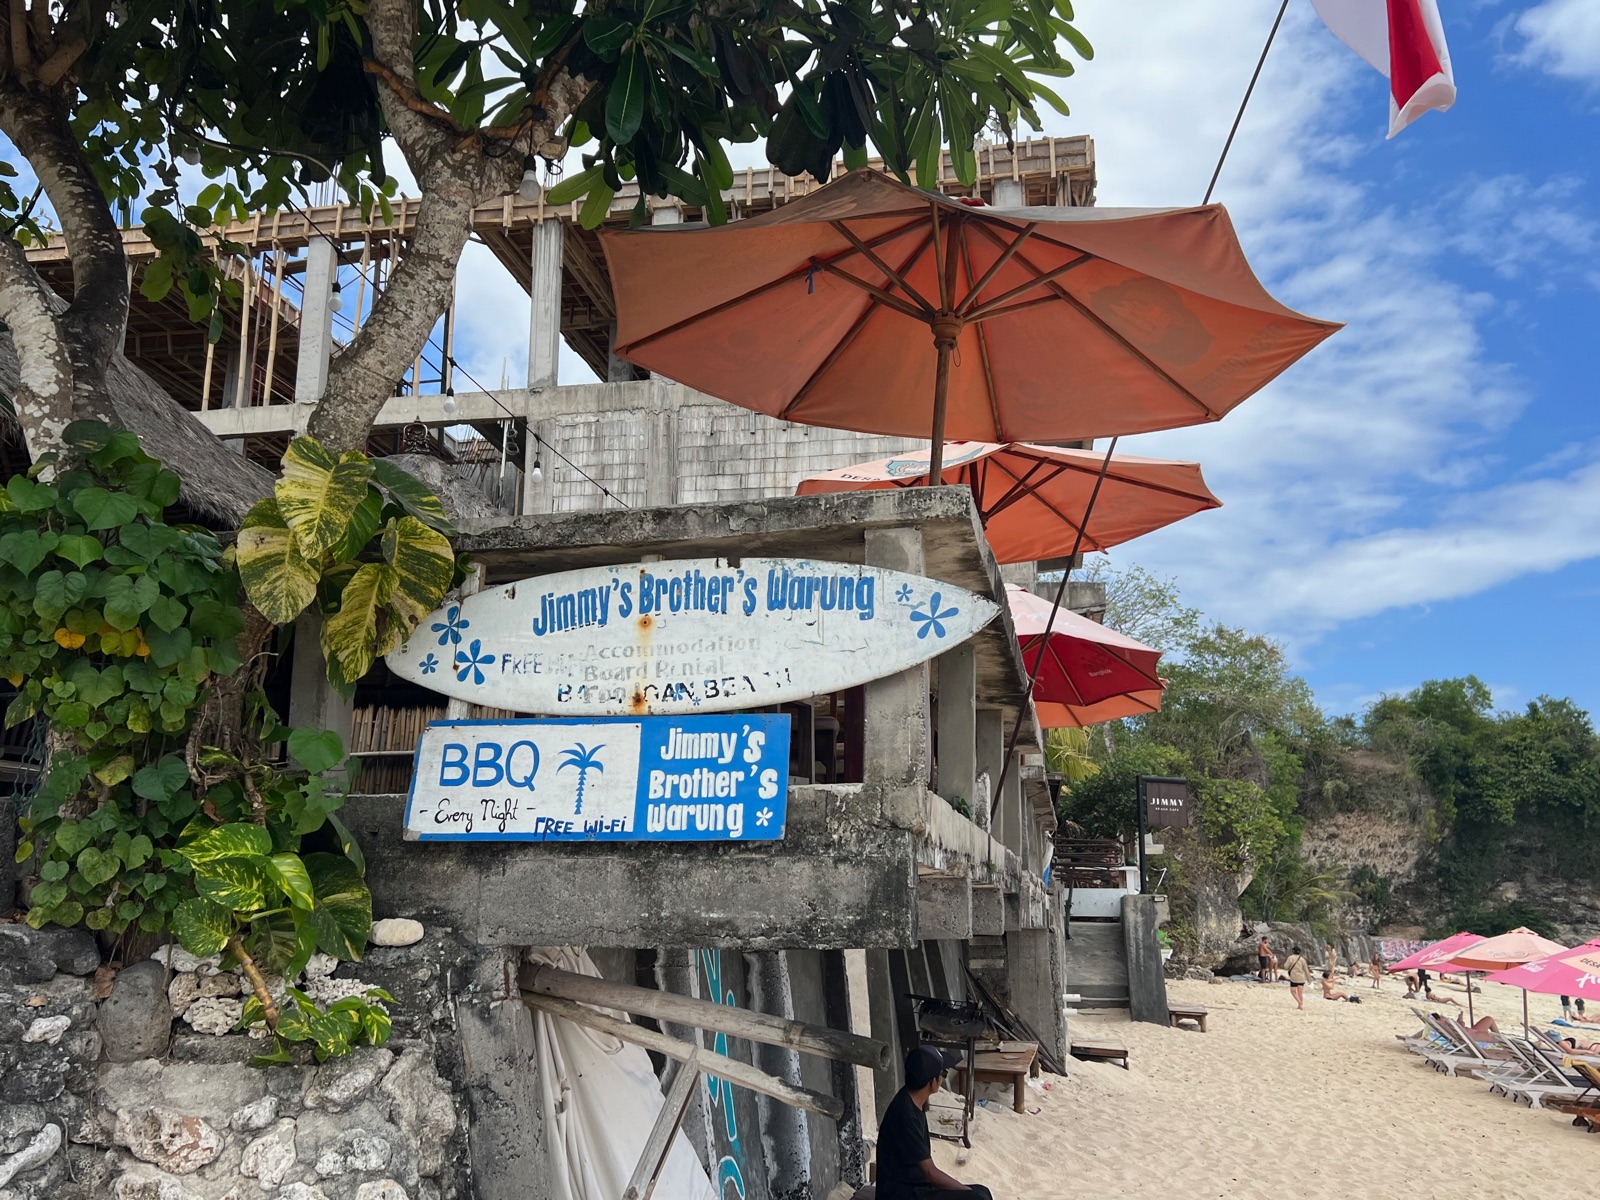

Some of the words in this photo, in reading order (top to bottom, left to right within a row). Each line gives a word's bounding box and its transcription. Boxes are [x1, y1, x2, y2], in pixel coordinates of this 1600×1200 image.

[532, 578, 633, 637] Jimmy's
[639, 569, 757, 618] Brother's
[767, 569, 875, 620] Warung
[583, 661, 648, 682] Board
[660, 724, 766, 764] Jimmy's
[439, 740, 540, 791] BBQ
[648, 764, 779, 800] Brother's
[434, 798, 473, 833] Every
[480, 798, 519, 832] Night
[1150, 797, 1184, 807] JIMMY
[533, 817, 574, 841] FREE
